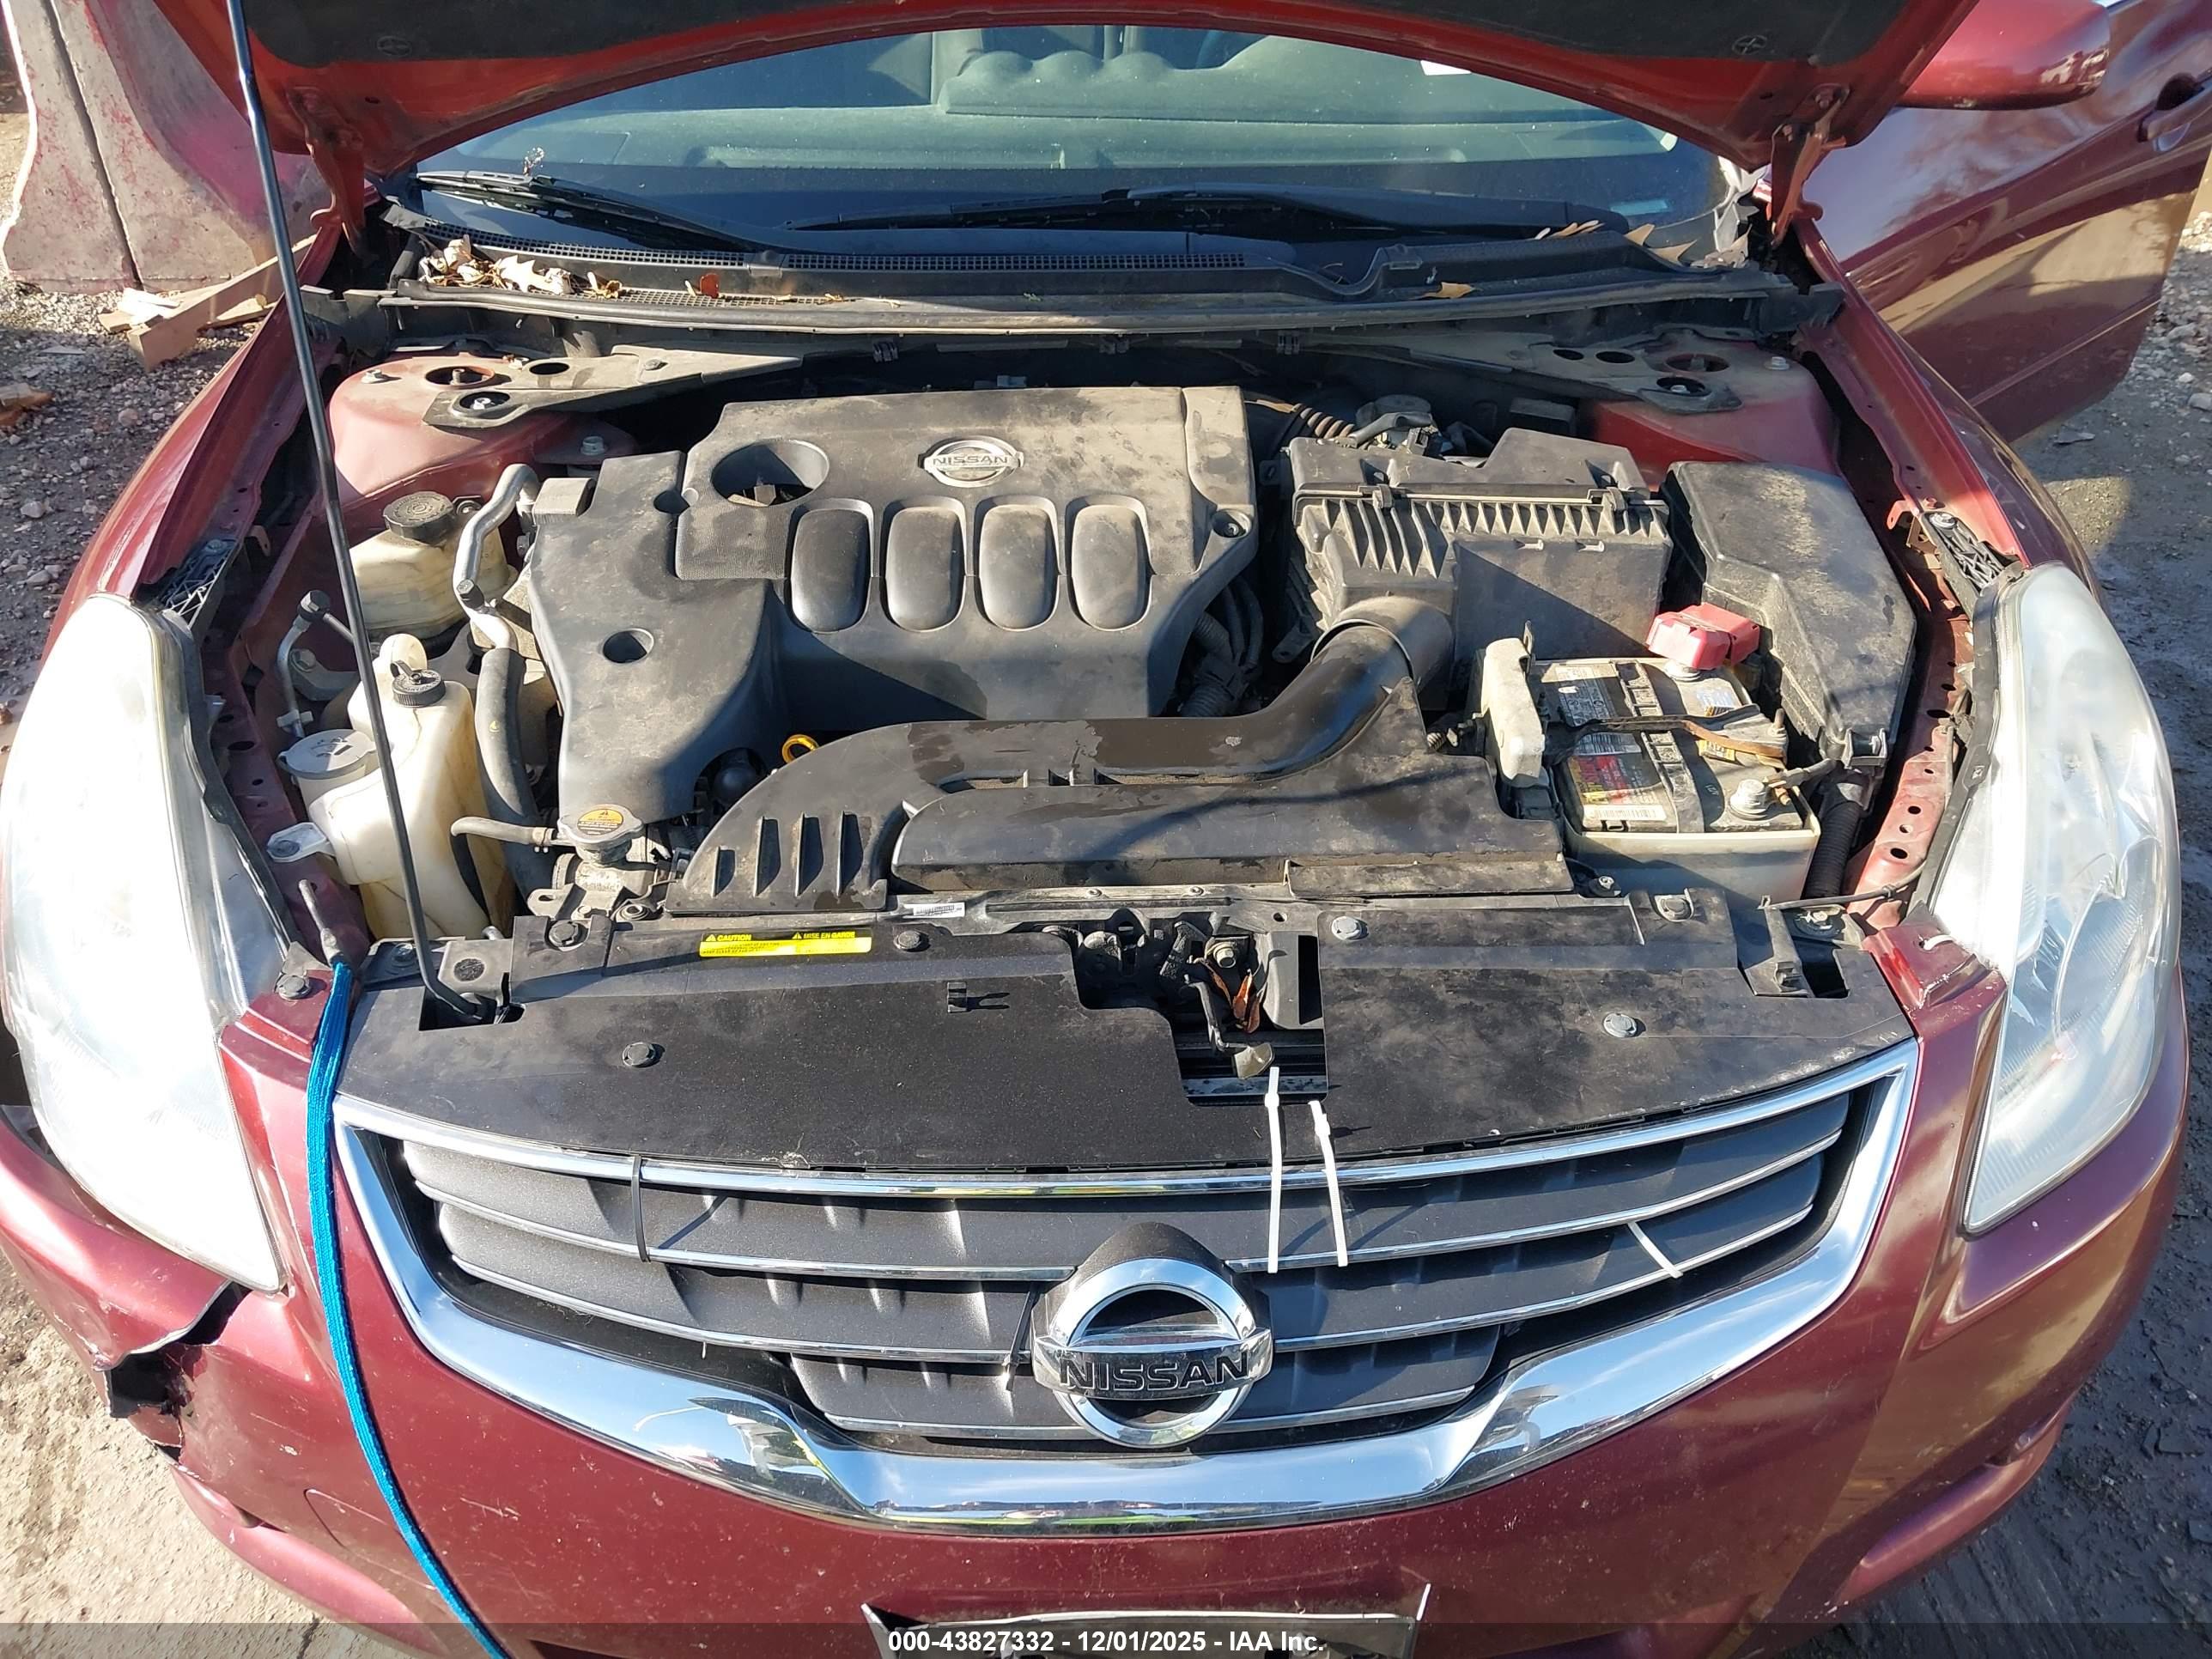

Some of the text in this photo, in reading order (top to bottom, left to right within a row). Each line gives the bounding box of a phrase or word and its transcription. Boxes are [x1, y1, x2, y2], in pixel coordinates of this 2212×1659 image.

[933, 456, 1008, 465] NISSAN
[716, 933, 752, 942] CAUTION
[803, 932, 820, 940] MISE
[1059, 1351, 1249, 1392] NISSAN
